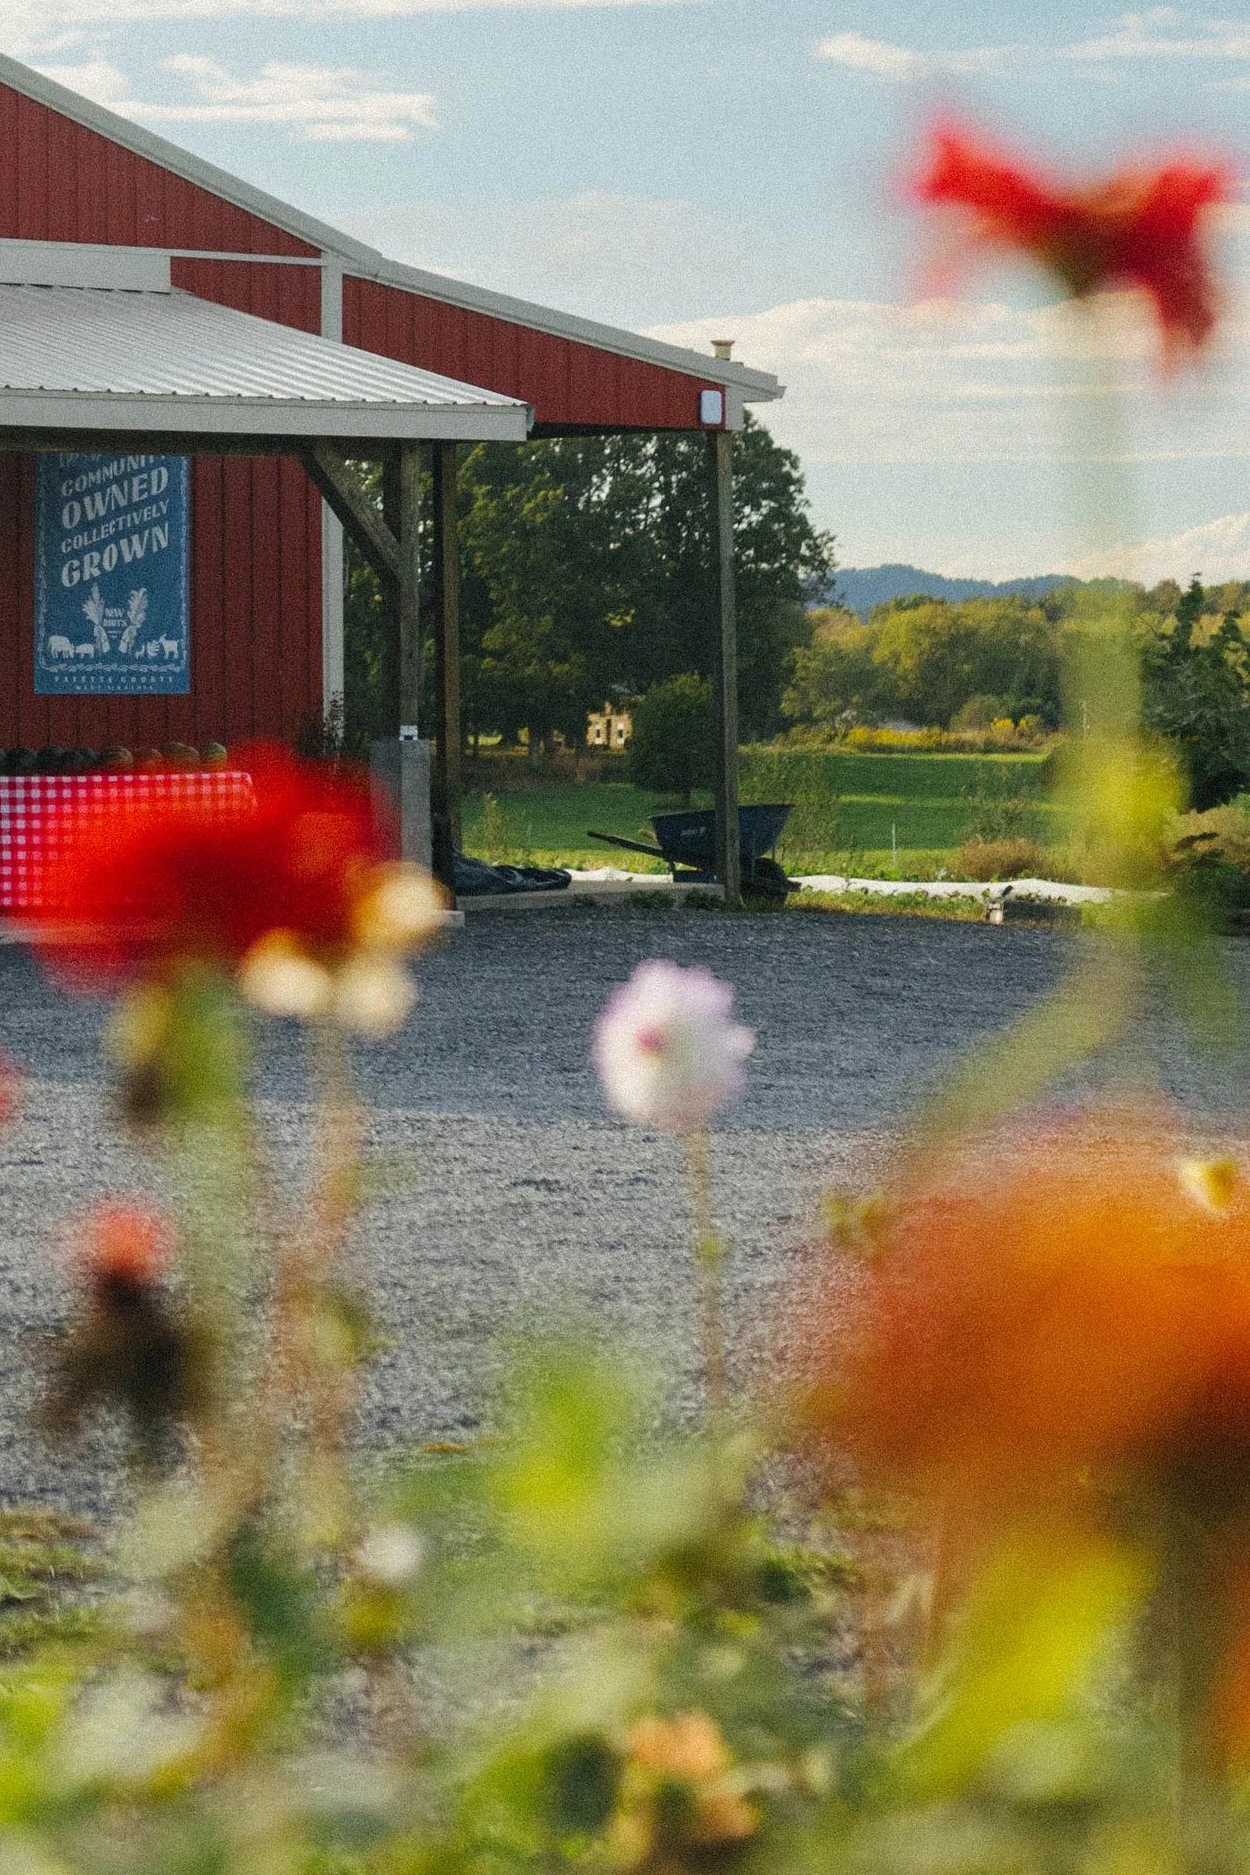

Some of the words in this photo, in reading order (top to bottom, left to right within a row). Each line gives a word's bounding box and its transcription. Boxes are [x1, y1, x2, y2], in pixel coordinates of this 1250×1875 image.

[61, 454, 166, 497] COMMUNI
[61, 466, 169, 530] OWNED
[61, 499, 170, 554] COLLECTIVELY
[61, 522, 169, 588] GROWN
[54, 675, 113, 684] FAYETTE
[120, 675, 174, 684] COUNTY
